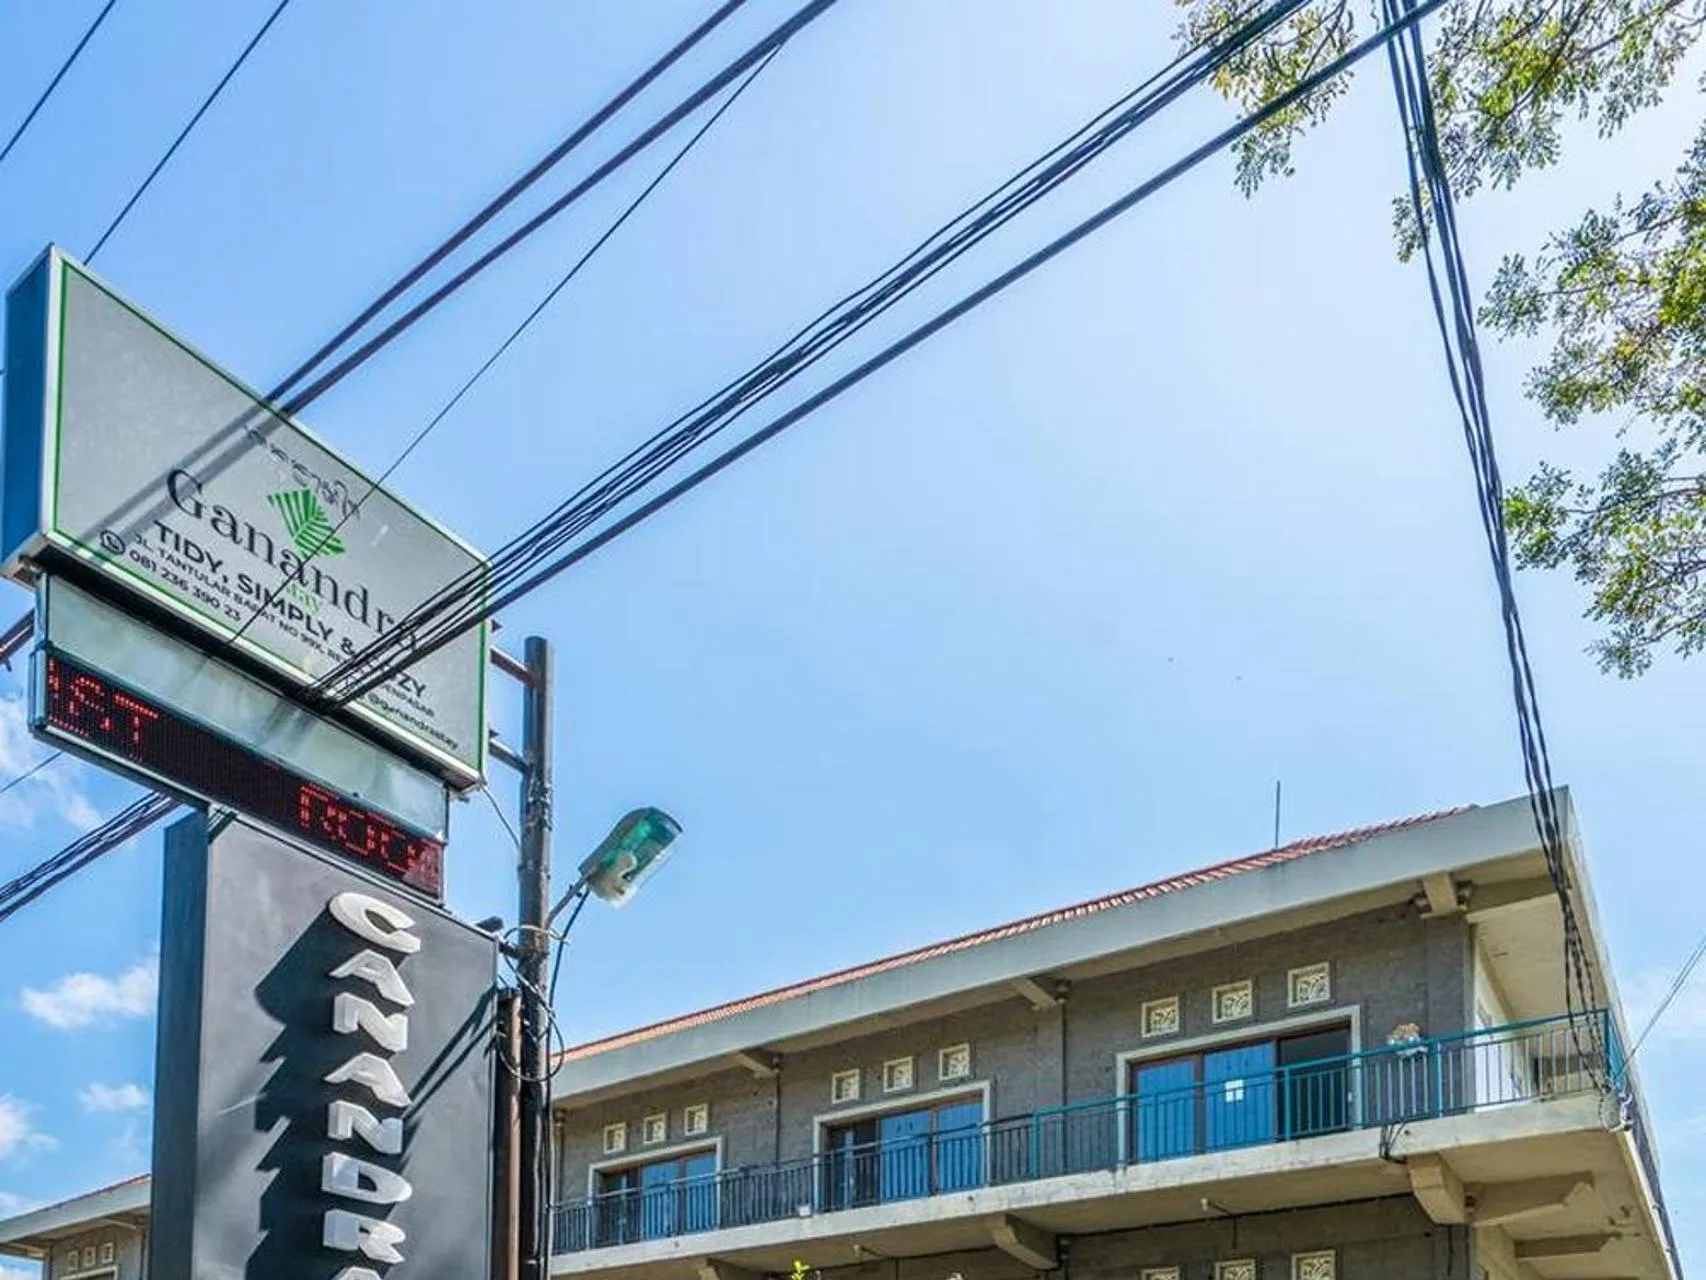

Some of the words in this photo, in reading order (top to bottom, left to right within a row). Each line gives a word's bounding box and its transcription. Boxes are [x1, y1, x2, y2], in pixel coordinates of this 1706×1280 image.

[129, 548, 157, 573] 081
[161, 566, 189, 592] 236
[224, 603, 242, 622] 23
[153, 519, 228, 583] TIDY,
[237, 573, 333, 641] SIMPLY
[340, 636, 356, 656] &
[160, 547, 232, 597] TANTULAR
